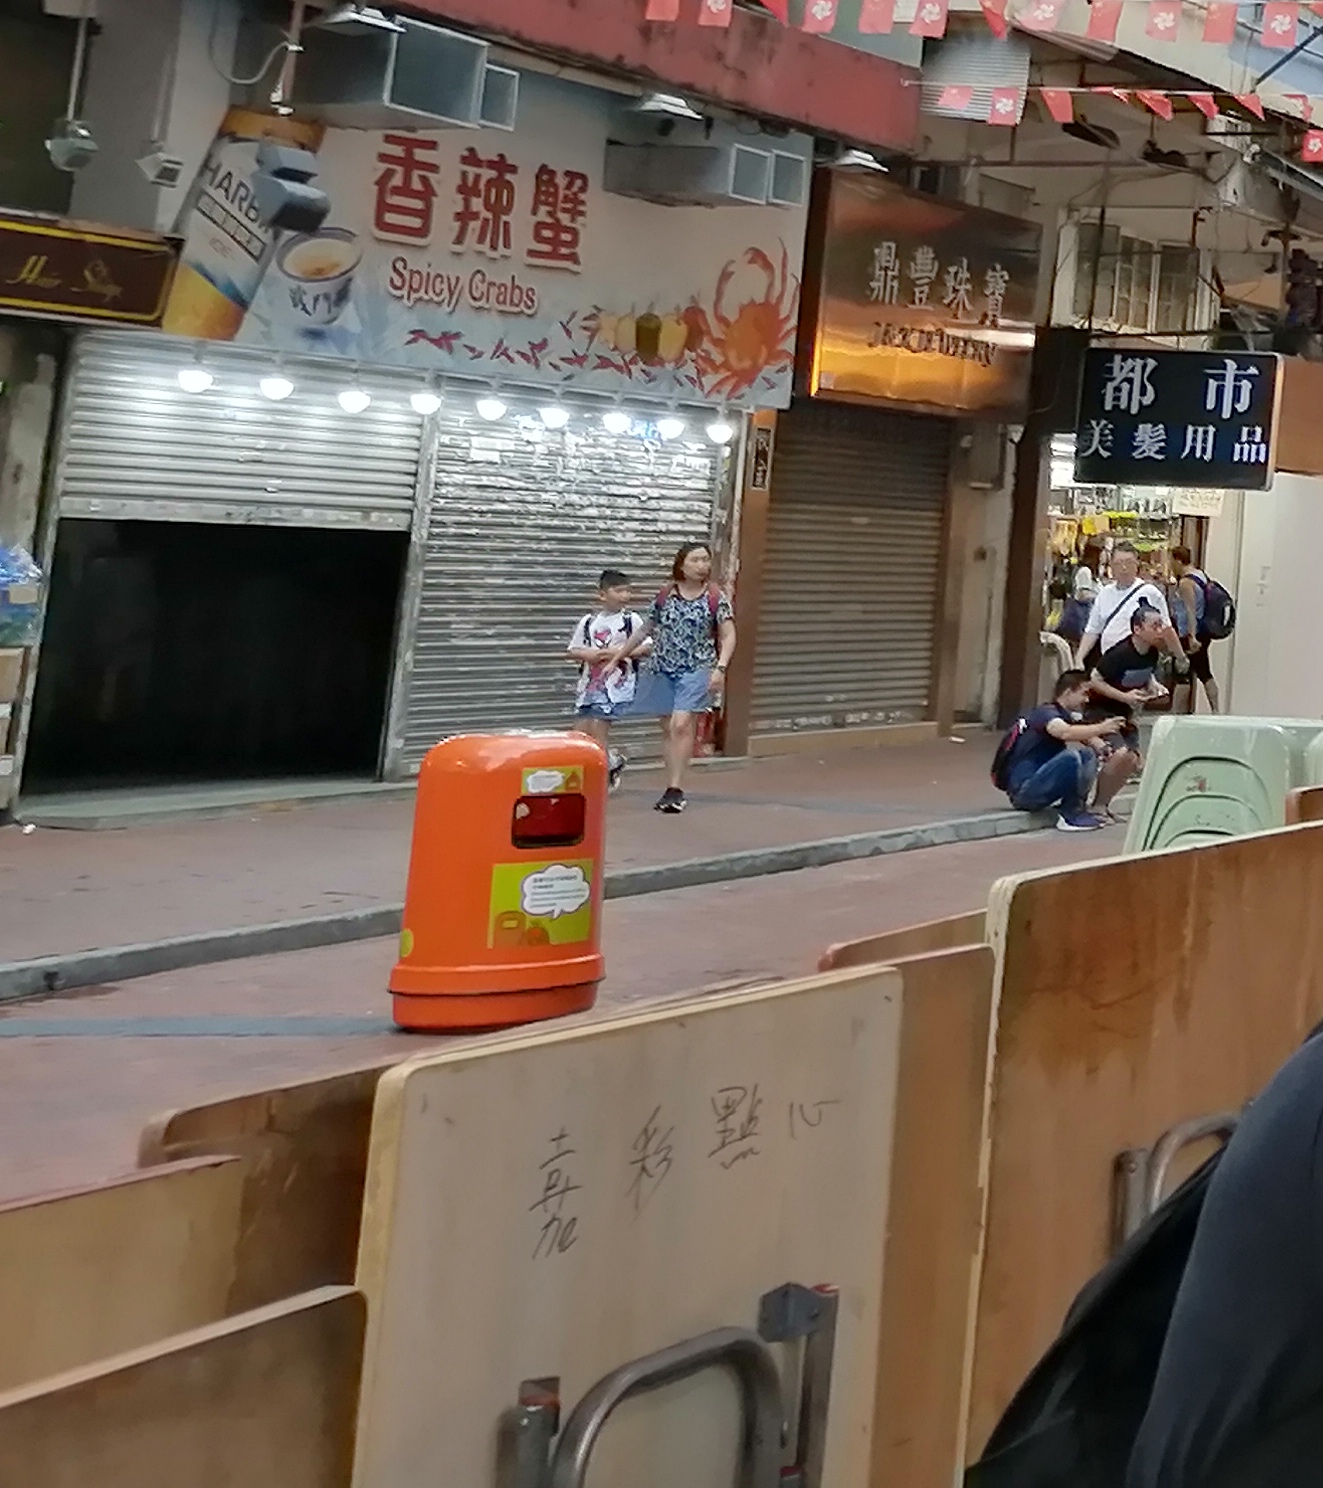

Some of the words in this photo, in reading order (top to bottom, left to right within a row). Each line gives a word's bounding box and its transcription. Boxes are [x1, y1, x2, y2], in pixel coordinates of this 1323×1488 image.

[373, 132, 590, 269] 香辣蟹
[389, 256, 462, 311] Spicy
[468, 268, 538, 312] Crabs
[1101, 354, 1260, 420] 都市
[1079, 419, 1267, 464] 美髮用品
